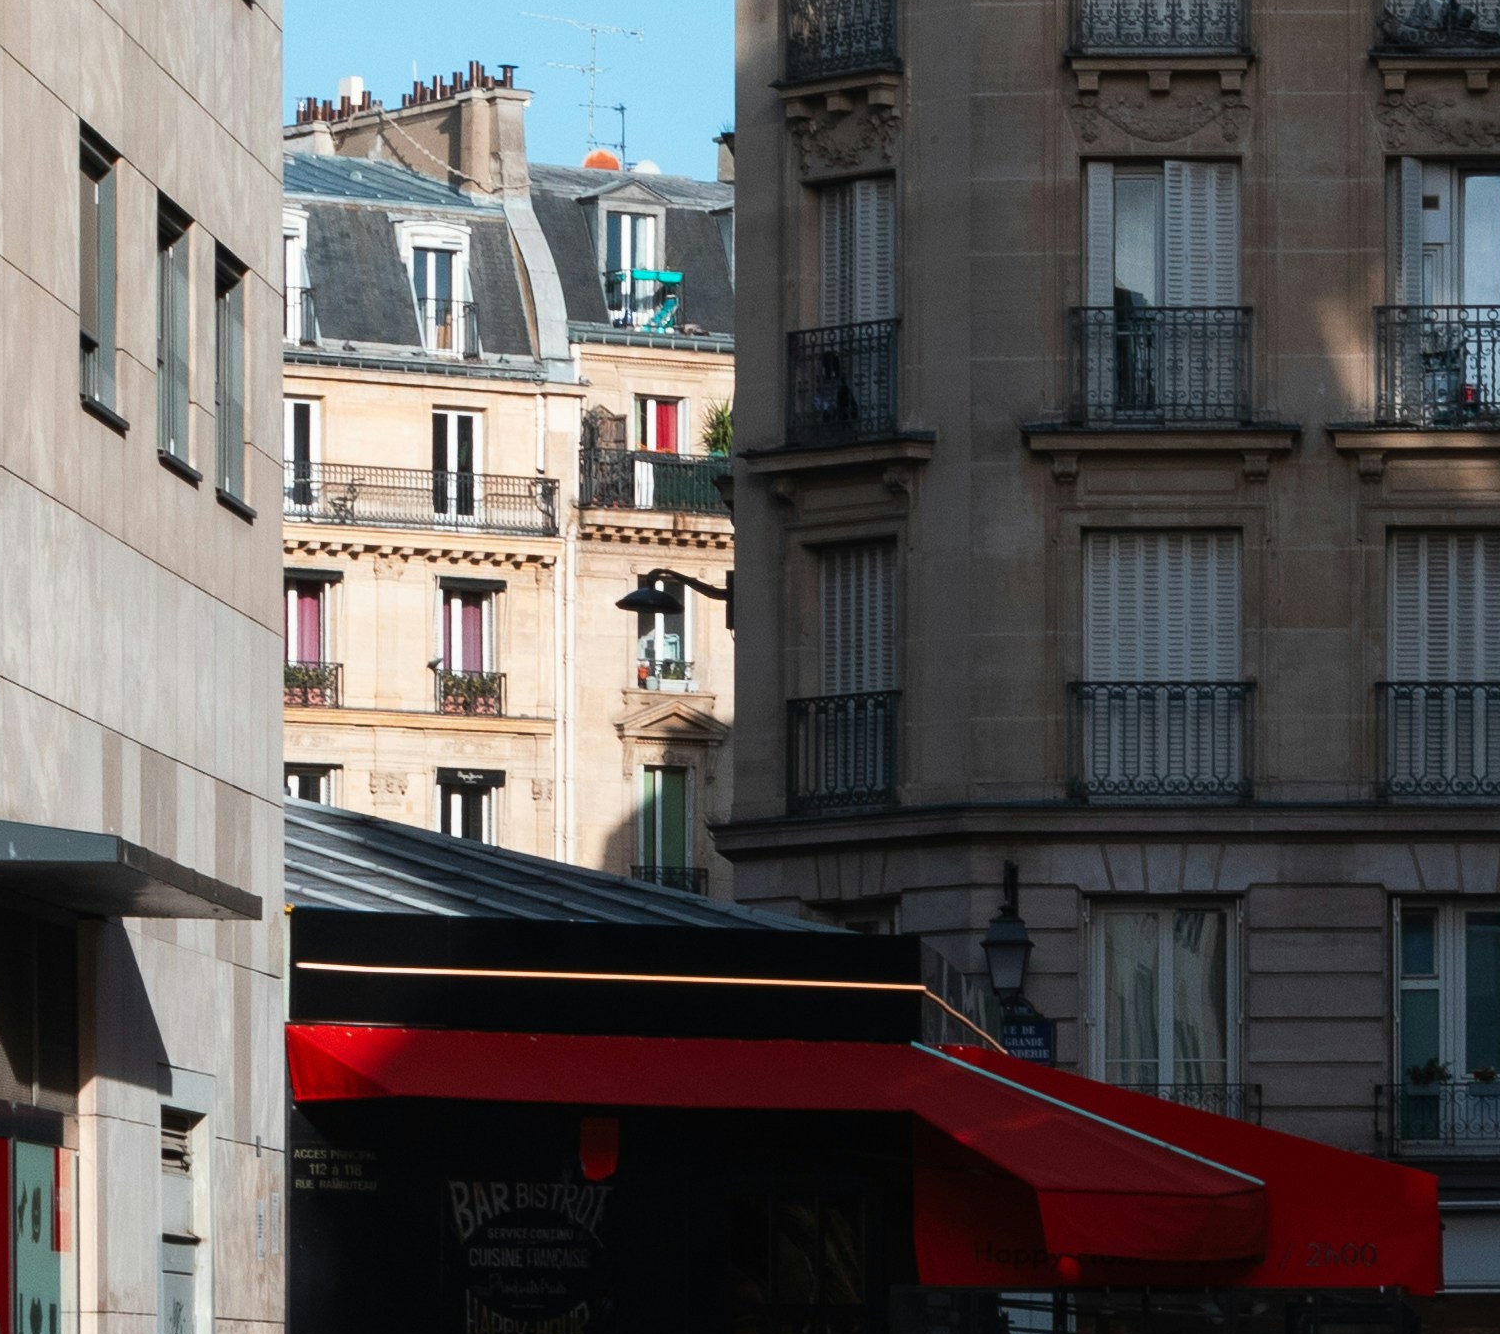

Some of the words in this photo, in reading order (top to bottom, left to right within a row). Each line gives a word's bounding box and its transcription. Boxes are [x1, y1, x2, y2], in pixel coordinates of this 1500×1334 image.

[1022, 1025, 1036, 1035] DE
[1005, 1037, 1044, 1046] GRANDE
[308, 1162, 327, 1176] 112
[446, 1178, 512, 1244] BAR
[516, 1182, 614, 1245] BISTROT
[487, 1227, 528, 1240] SERVICE
[468, 1247, 523, 1267] CUISINE
[1305, 1241, 1379, 1268] 2h00
